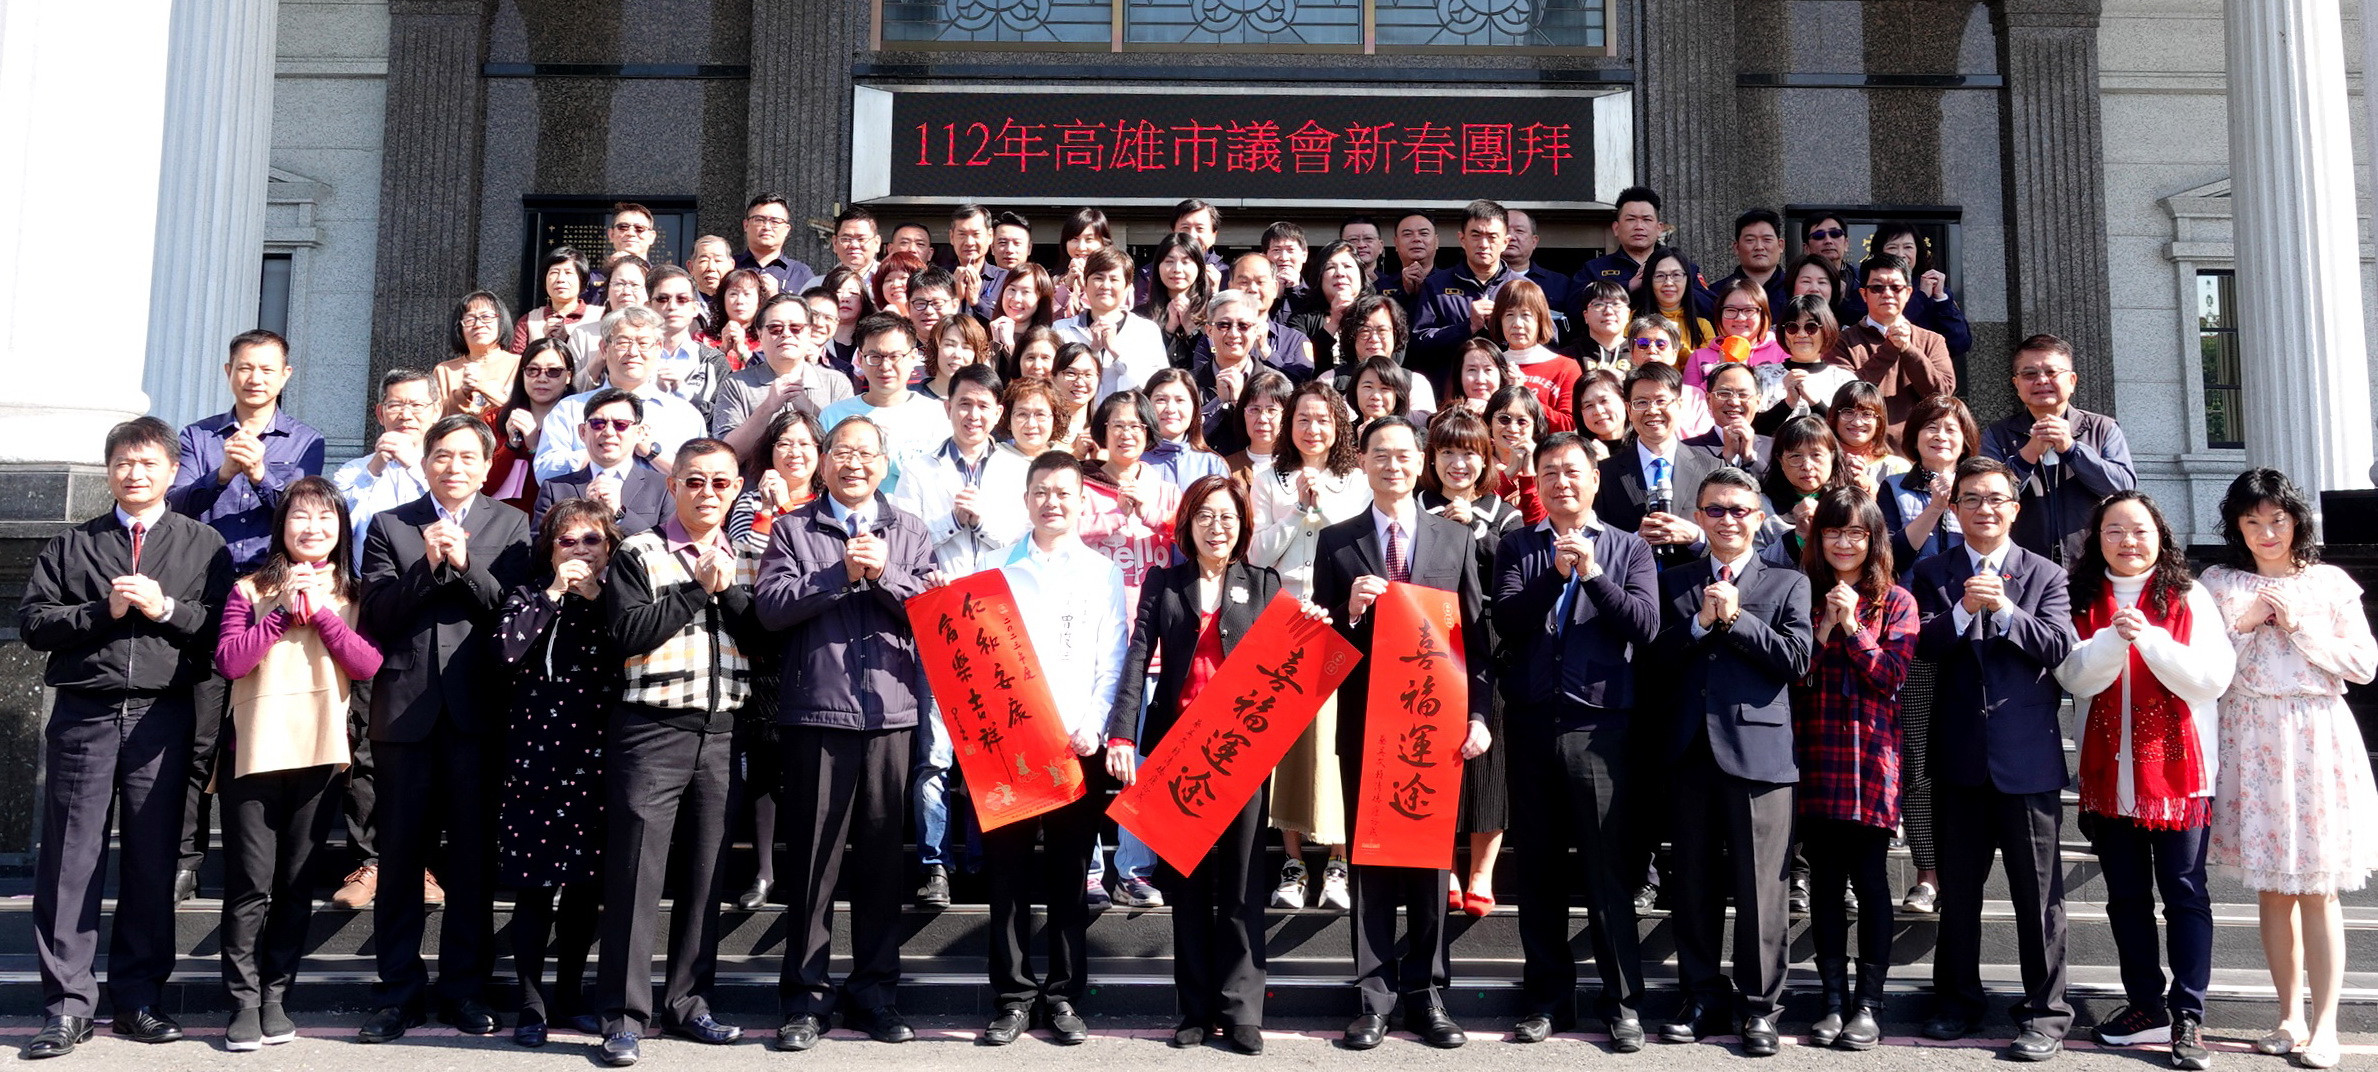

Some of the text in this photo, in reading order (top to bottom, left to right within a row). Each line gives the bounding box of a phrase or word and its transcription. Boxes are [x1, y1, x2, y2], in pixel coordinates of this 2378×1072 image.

[915, 117, 1573, 176] 112年高雄市議會新春團拜
[1168, 647, 1304, 819] 喜福運途
[1389, 618, 1448, 821] 喜福運途
